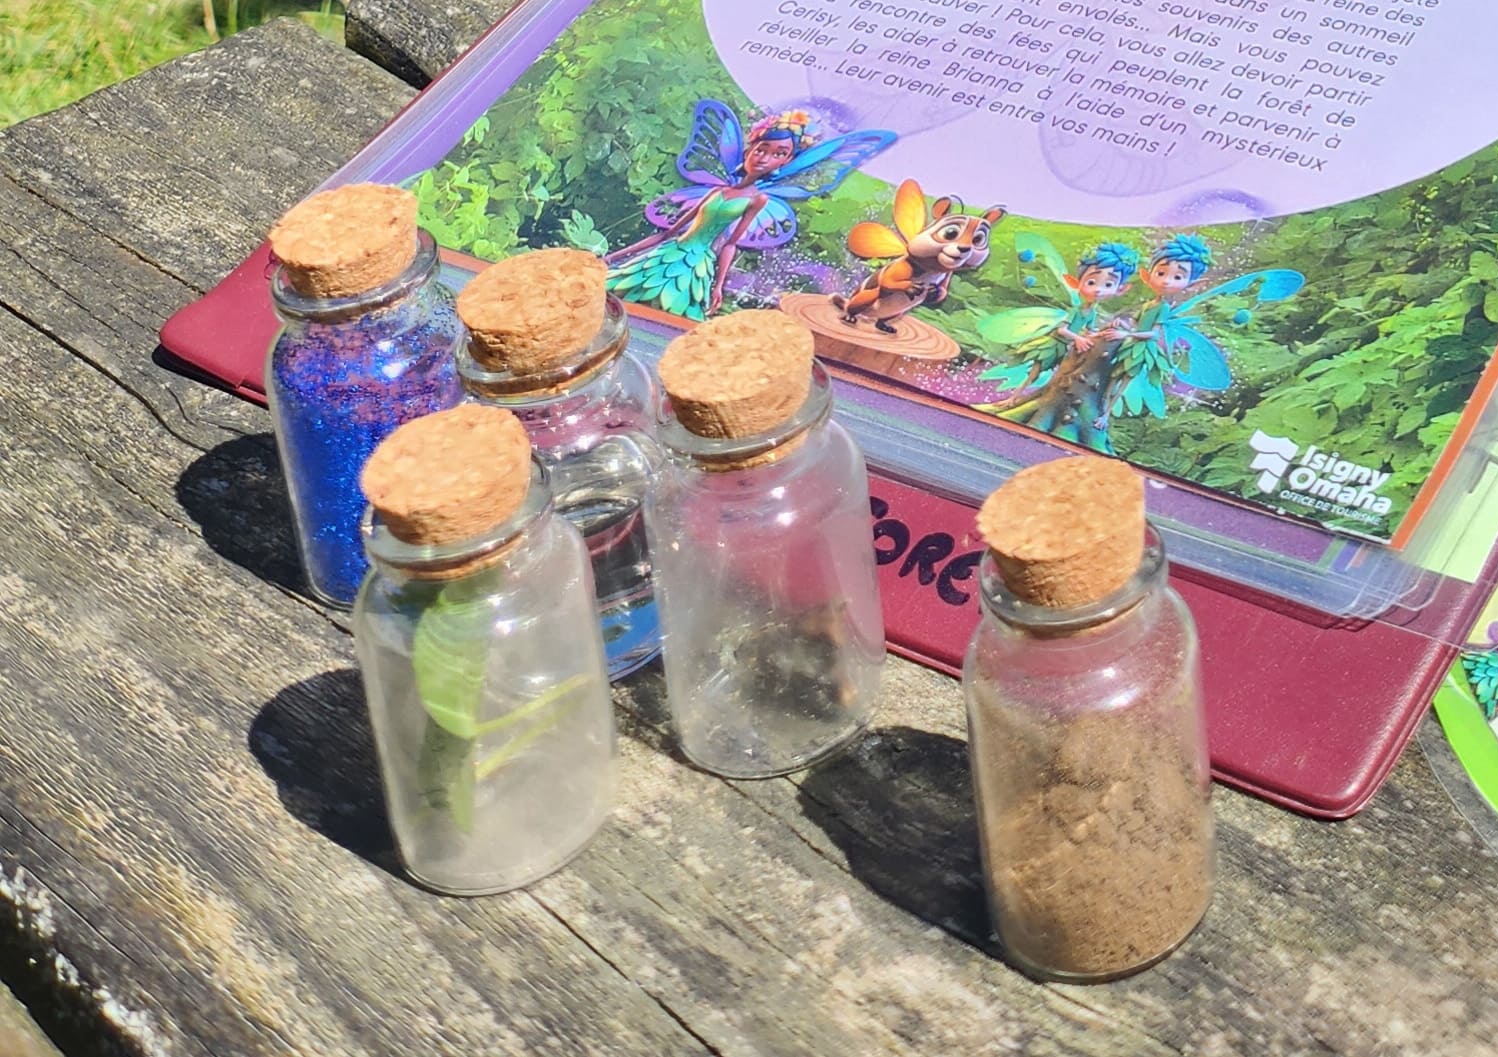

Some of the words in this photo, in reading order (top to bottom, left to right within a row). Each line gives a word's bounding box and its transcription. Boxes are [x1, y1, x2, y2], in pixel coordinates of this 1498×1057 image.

[1156, 1, 1260, 34] souvenirs
[1271, 25, 1313, 46] des
[1326, 40, 1399, 67] autres
[1279, 6, 1308, 23] un
[1318, 15, 1417, 47] sommeil
[1383, 6, 1426, 28] des
[777, 0, 843, 29] Cerisy,
[846, 14, 879, 35] les
[882, 26, 940, 49] aider
[940, 37, 959, 54] à
[960, 45, 1062, 78] retrouver
[1060, 66, 1086, 86] la
[1088, 77, 1187, 110] mémoire
[1192, 102, 1218, 119] et
[1218, 110, 1321, 143] parvenir
[1323, 131, 1343, 150] à
[957, 19, 997, 40] des
[1006, 30, 1054, 54] fées
[1064, 47, 1104, 66] qui
[1106, 58, 1210, 92] peuplent
[1219, 80, 1244, 101] la
[1255, 90, 1313, 118] forêt
[1324, 108, 1356, 128] de
[989, 3, 1004, 19] !
[1003, 6, 1056, 31] Pour
[1057, 23, 1106, 47] cela,
[1117, 36, 1168, 58] vous
[1172, 49, 1226, 72] allez
[1230, 61, 1304, 90] devoir
[1302, 82, 1374, 107] partir
[1166, 22, 1222, 48] Mais
[1237, 40, 1289, 64] vous
[1298, 57, 1386, 87] pouvez
[756, 19, 839, 47] réveiller
[845, 37, 869, 56] la
[876, 48, 932, 71] reine
[941, 60, 1025, 94] Brianna
[1035, 84, 1054, 102] à
[1200, 129, 1329, 173] mystérieux
[833, 58, 883, 82] Leur
[882, 73, 951, 99] avenir
[950, 90, 987, 109] est
[987, 100, 1046, 124] entre
[1050, 114, 1089, 135] vos
[1090, 126, 1161, 154] mains
[1162, 140, 1178, 158] !
[1288, 468, 1393, 515] Omaha
[1299, 444, 1392, 490] Isigny
[1280, 489, 1316, 507] OFFICE
[1314, 499, 1332, 511] DE
[1331, 504, 1384, 525] TOURISME
